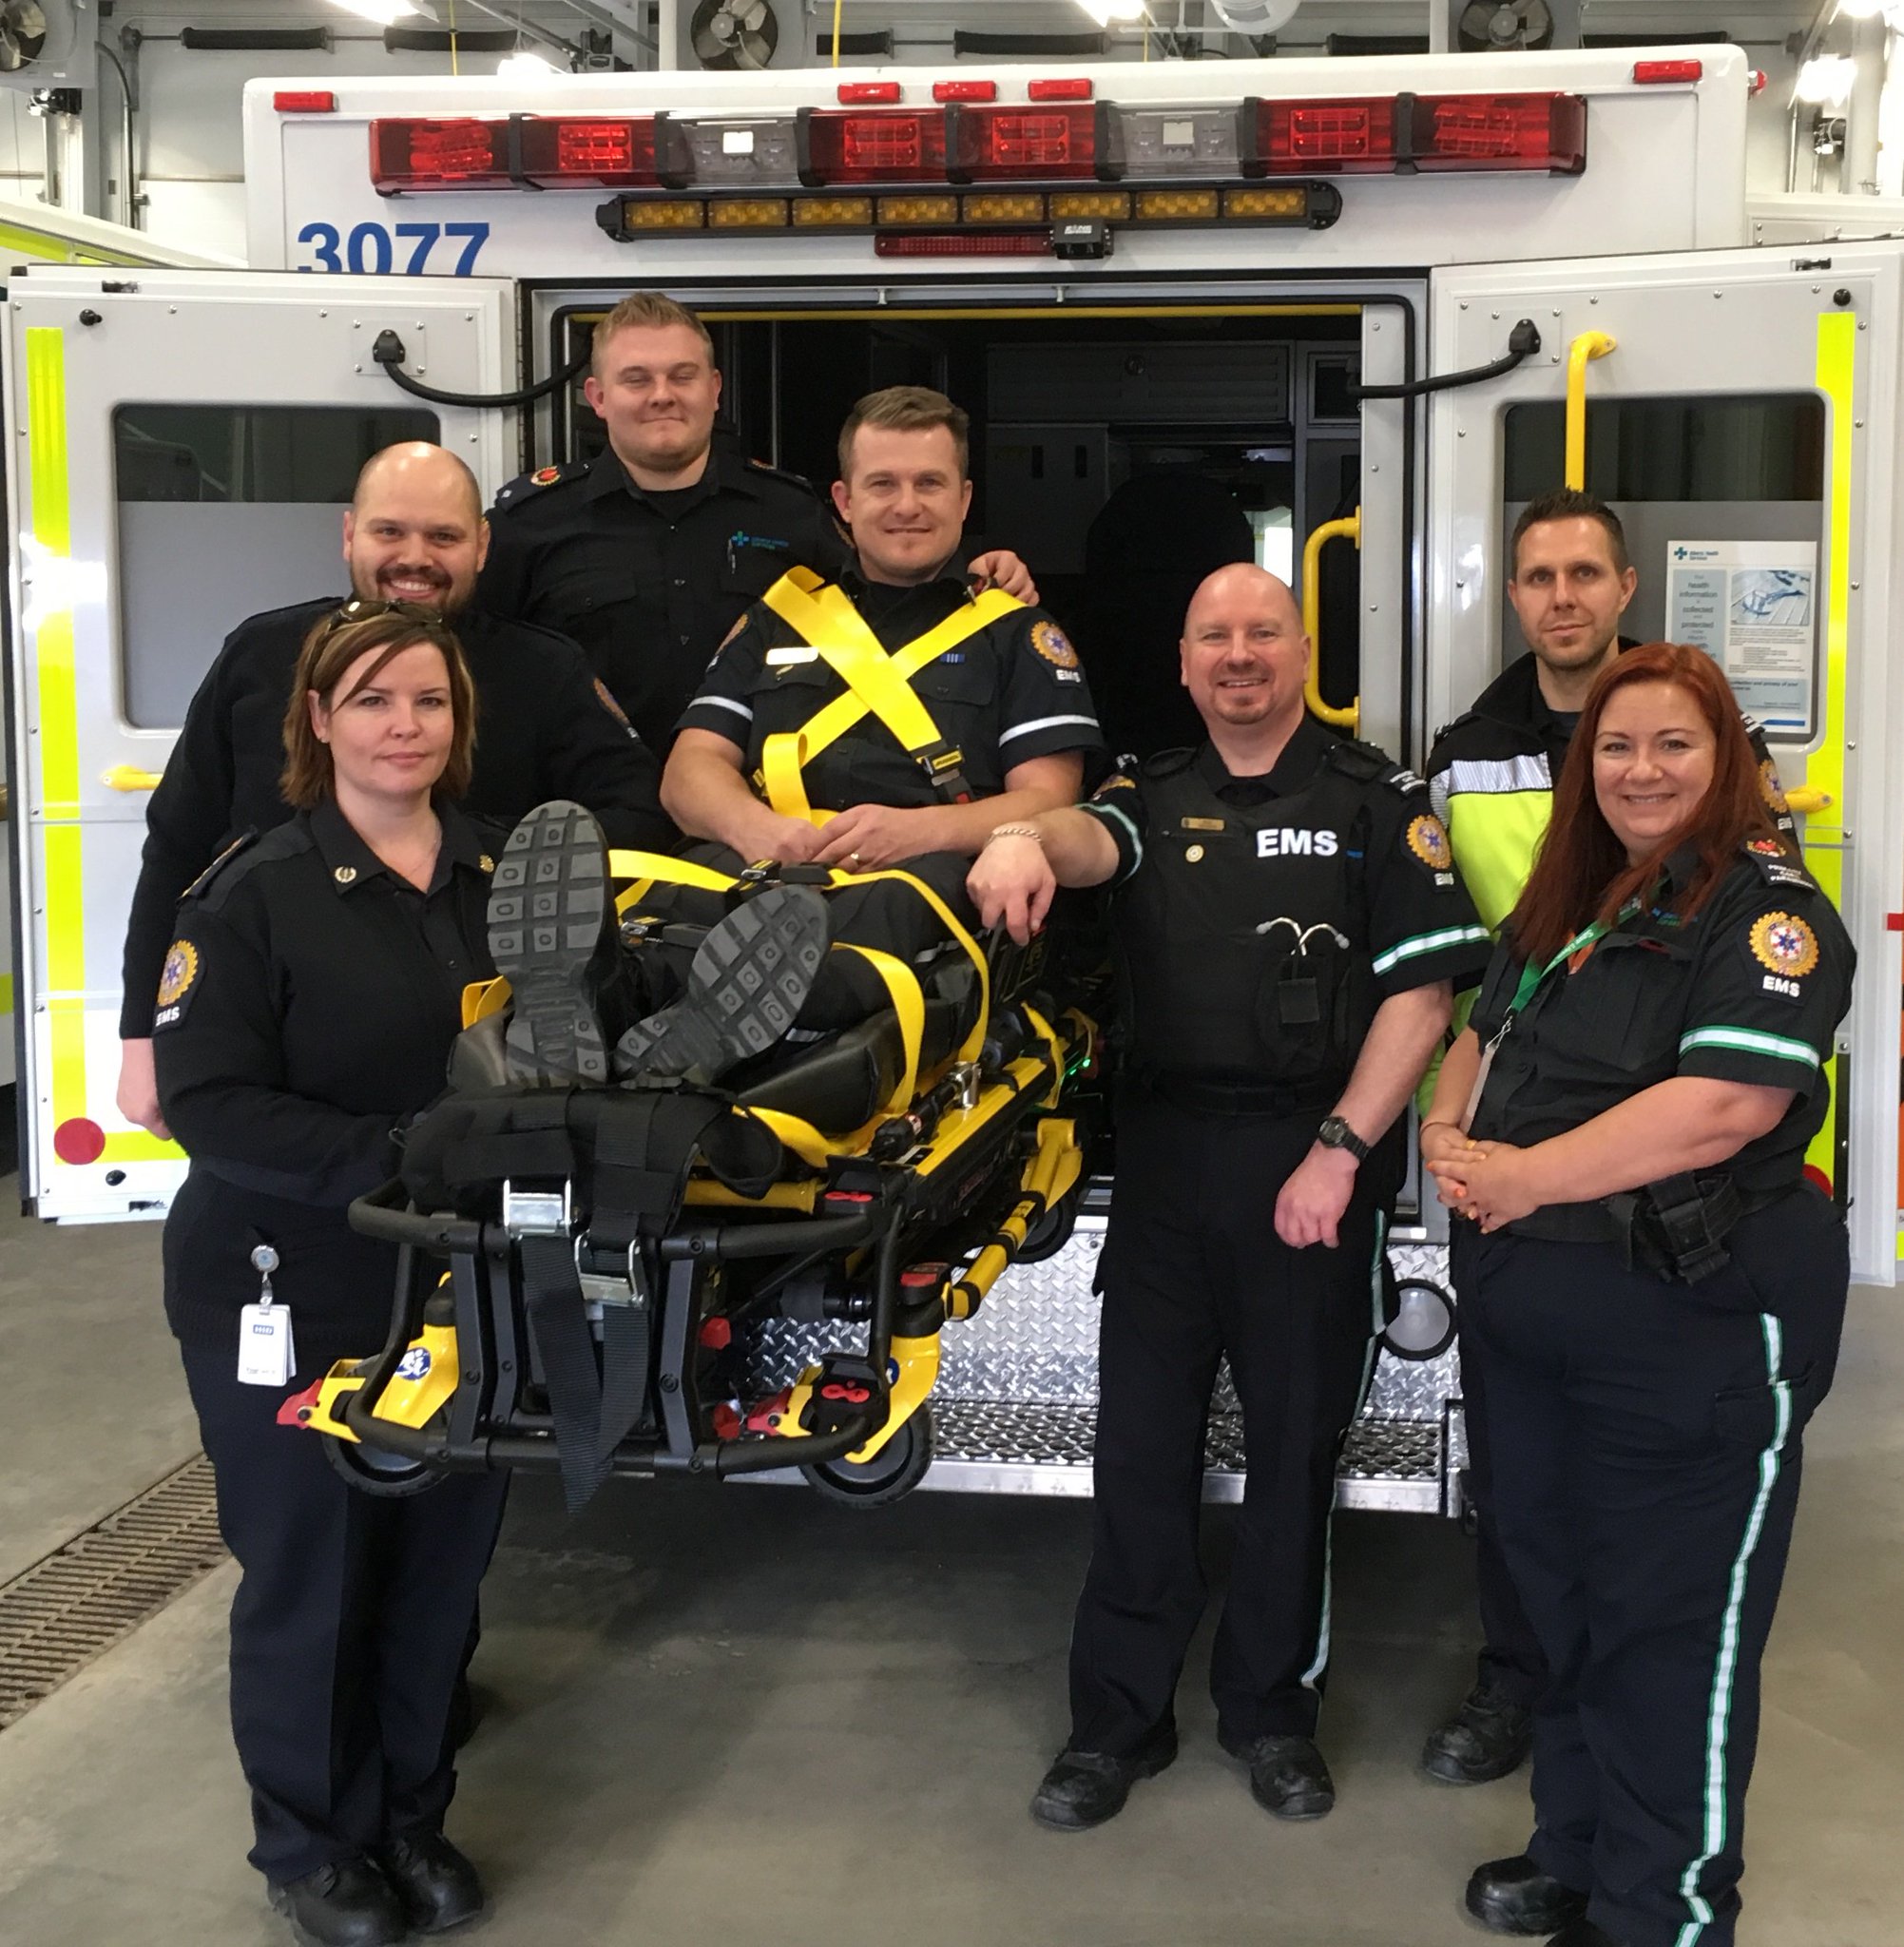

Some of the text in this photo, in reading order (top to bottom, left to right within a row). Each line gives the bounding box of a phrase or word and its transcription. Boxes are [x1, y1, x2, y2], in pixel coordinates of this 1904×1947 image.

[298, 222, 490, 277] 3077
[1056, 668, 1081, 683] EMS
[1257, 828, 1338, 858] EMS
[1762, 974, 1800, 997] EMS
[155, 1006, 181, 1027] EMS
